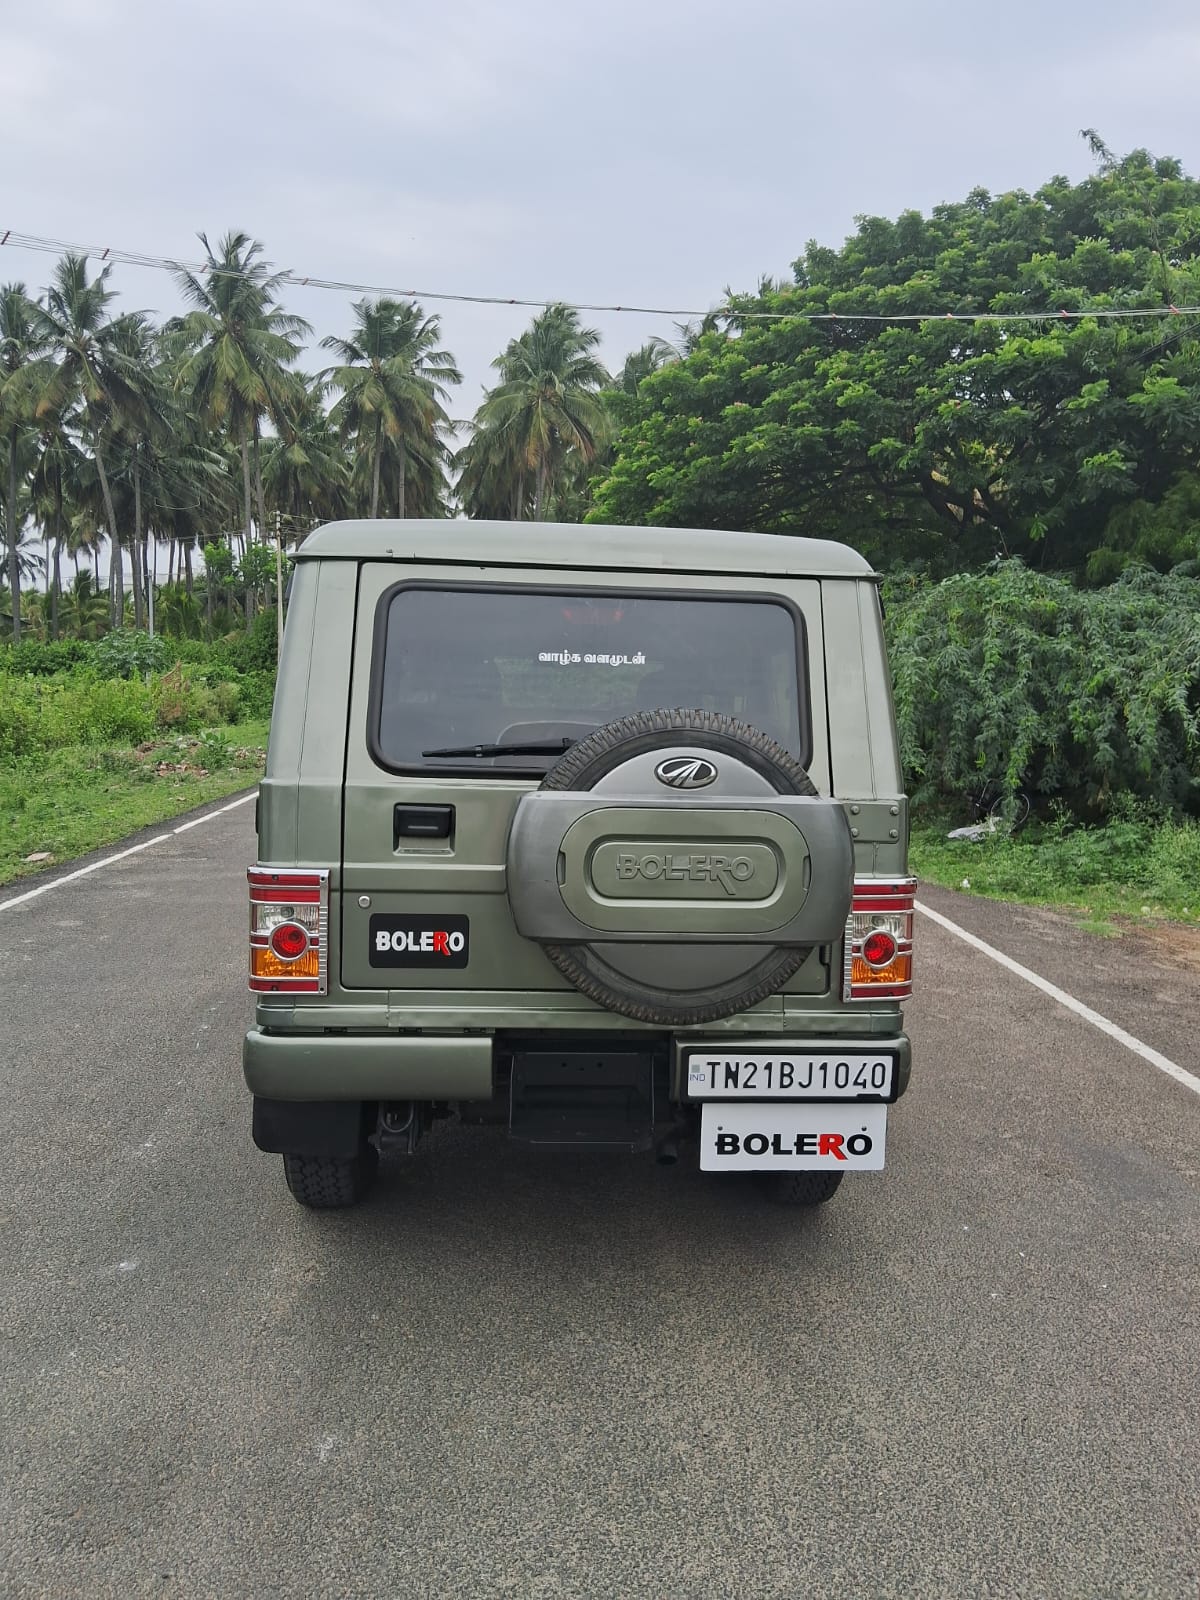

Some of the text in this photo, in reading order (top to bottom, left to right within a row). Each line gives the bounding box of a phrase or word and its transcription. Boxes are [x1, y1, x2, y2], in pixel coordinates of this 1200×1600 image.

[538, 649, 646, 667] வாழ்க வளமுடன்
[616, 854, 755, 895] BOLERO
[375, 930, 465, 956] BOLERO
[689, 1073, 706, 1082] IND
[706, 1061, 887, 1089] TN21BJ1040
[714, 1133, 873, 1160] BOLERO
